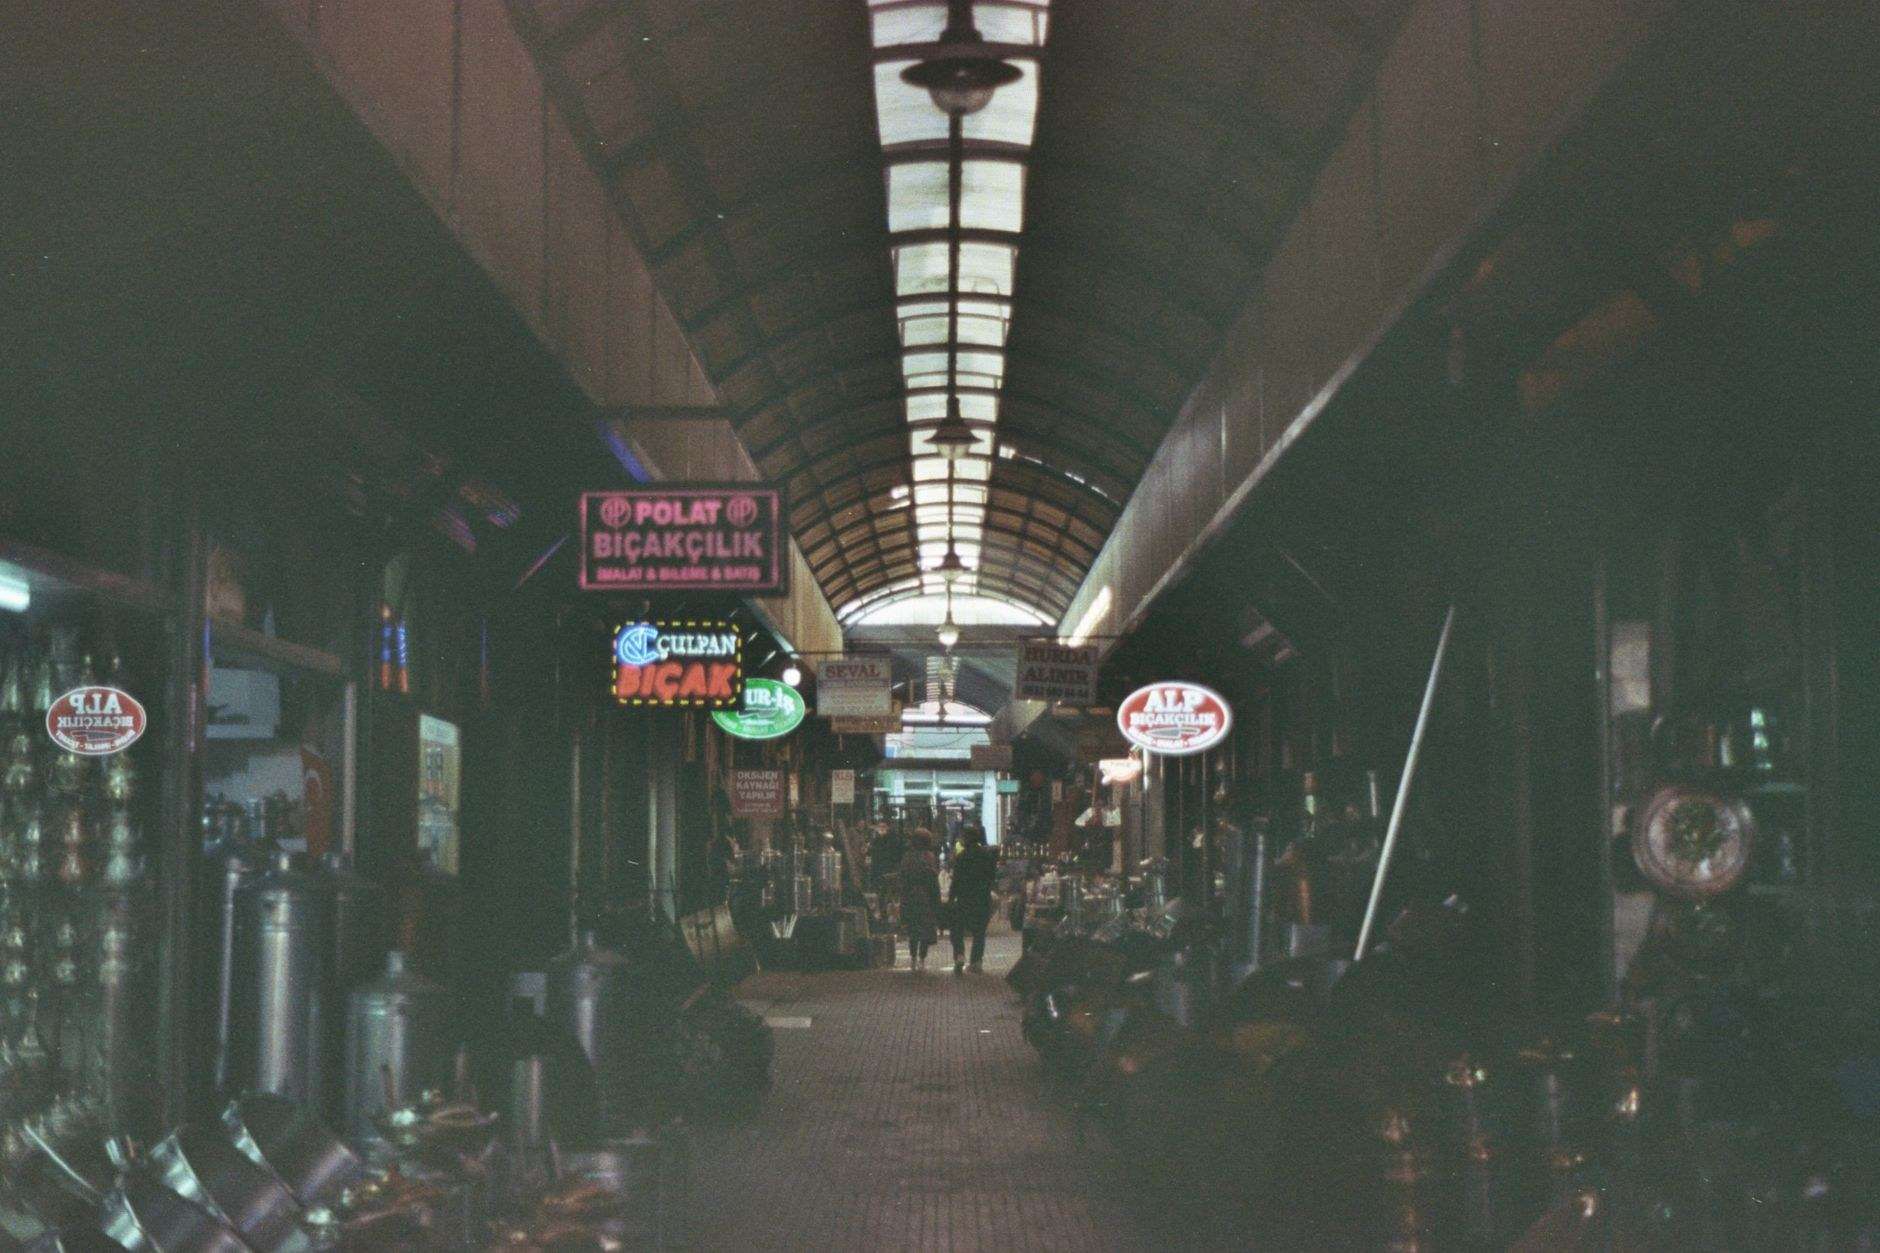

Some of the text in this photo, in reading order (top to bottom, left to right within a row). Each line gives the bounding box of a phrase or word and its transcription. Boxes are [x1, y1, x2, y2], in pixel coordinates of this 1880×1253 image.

[635, 500, 722, 526] POLAT
[593, 531, 763, 564] BIÇAKÇILIK
[1142, 688, 1204, 713] ALP
